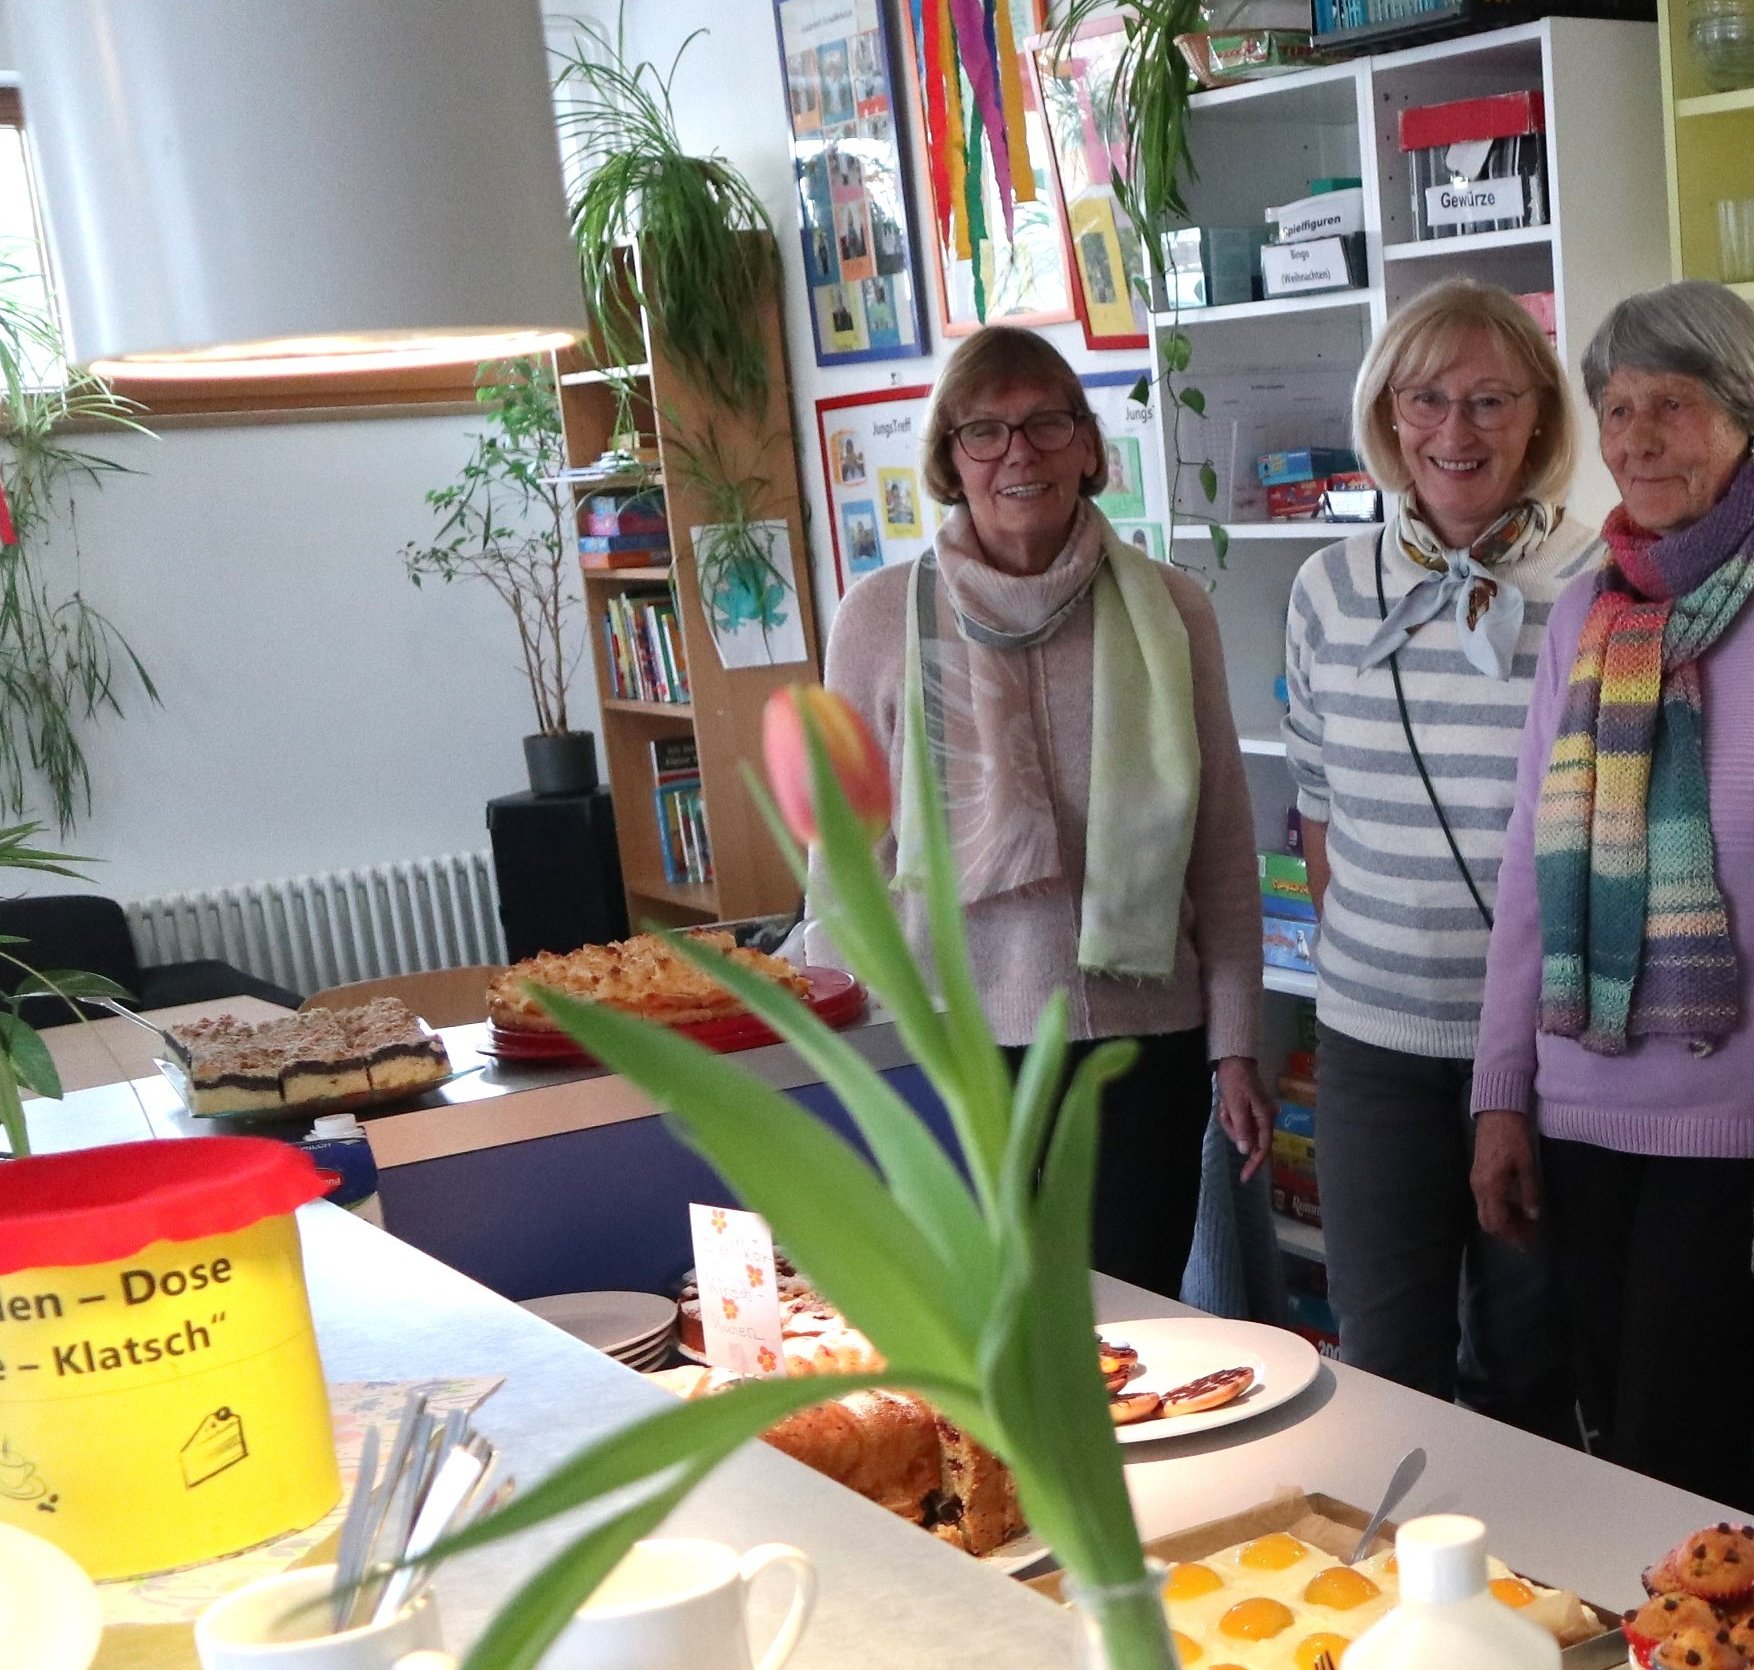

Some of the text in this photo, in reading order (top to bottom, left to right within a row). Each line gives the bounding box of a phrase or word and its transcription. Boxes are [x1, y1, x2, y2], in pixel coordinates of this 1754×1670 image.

[1440, 190, 1496, 209] Gewürze
[1282, 214, 1341, 237] Spielfiguren
[1281, 268, 1331, 285] (Weihnachten)
[1126, 405, 1155, 424] Jungs
[872, 416, 911, 438] JungsTreff
[0, 1292, 63, 1322] en
[120, 1257, 232, 1306] Dose
